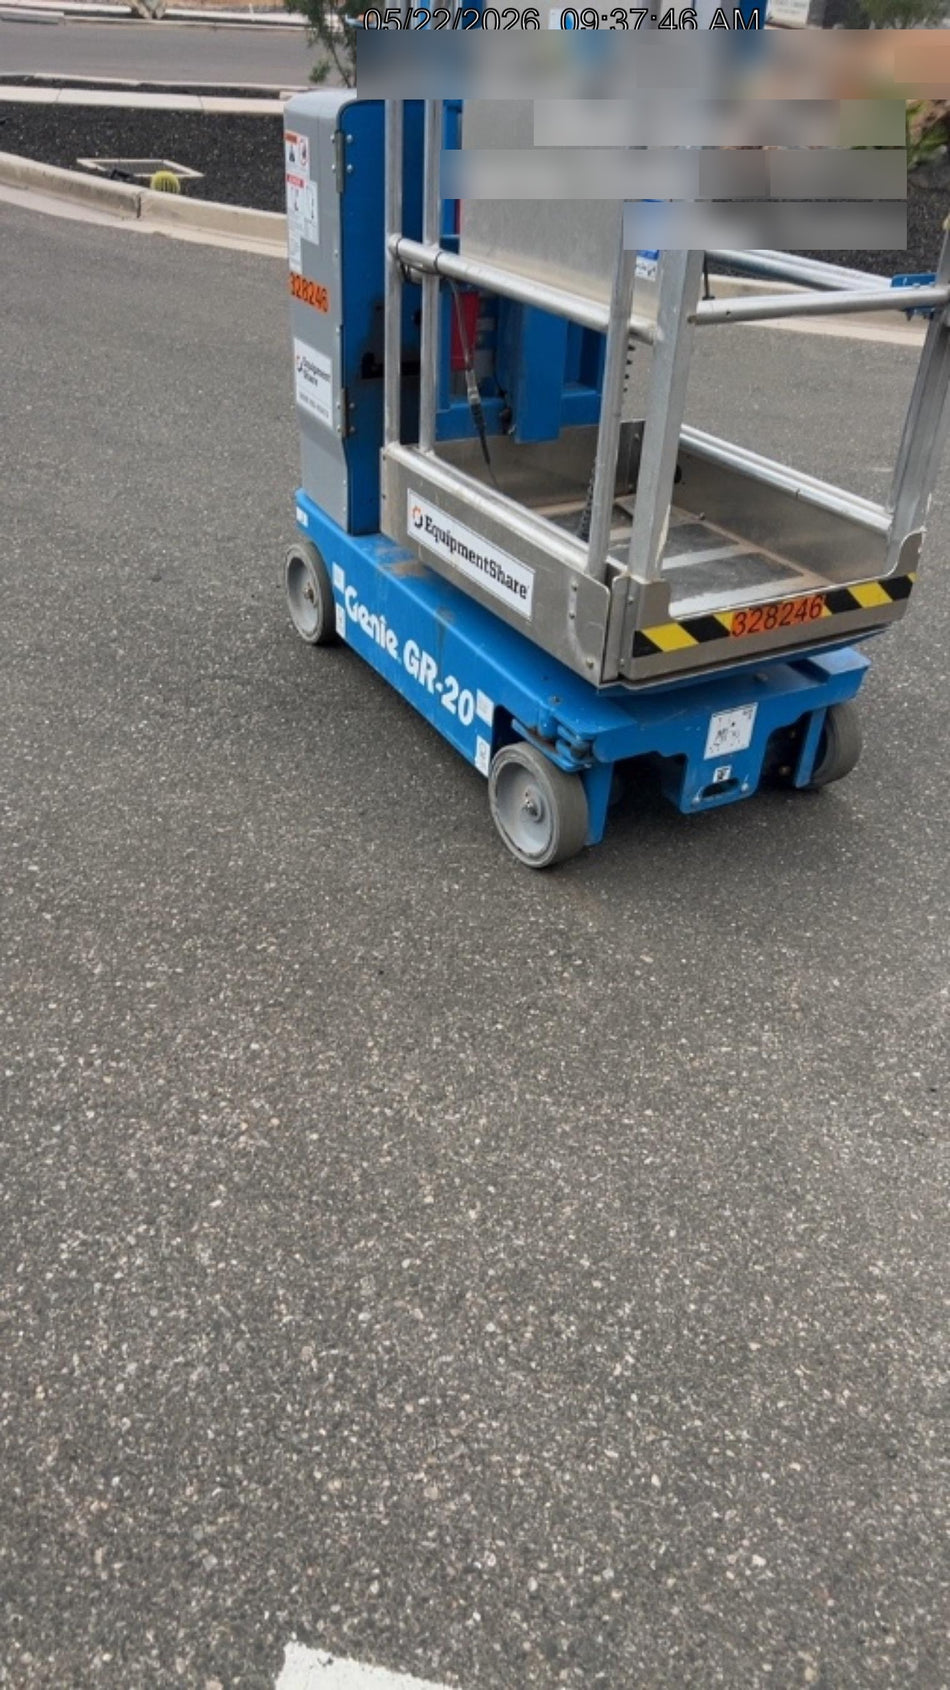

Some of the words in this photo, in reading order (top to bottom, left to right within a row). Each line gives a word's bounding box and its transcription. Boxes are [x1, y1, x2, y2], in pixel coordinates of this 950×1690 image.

[290, 271, 328, 312] 328246
[424, 514, 528, 600] EquipmentShare
[731, 596, 822, 638] 328246
[344, 585, 399, 657] Genie
[403, 639, 475, 726] GR-20
